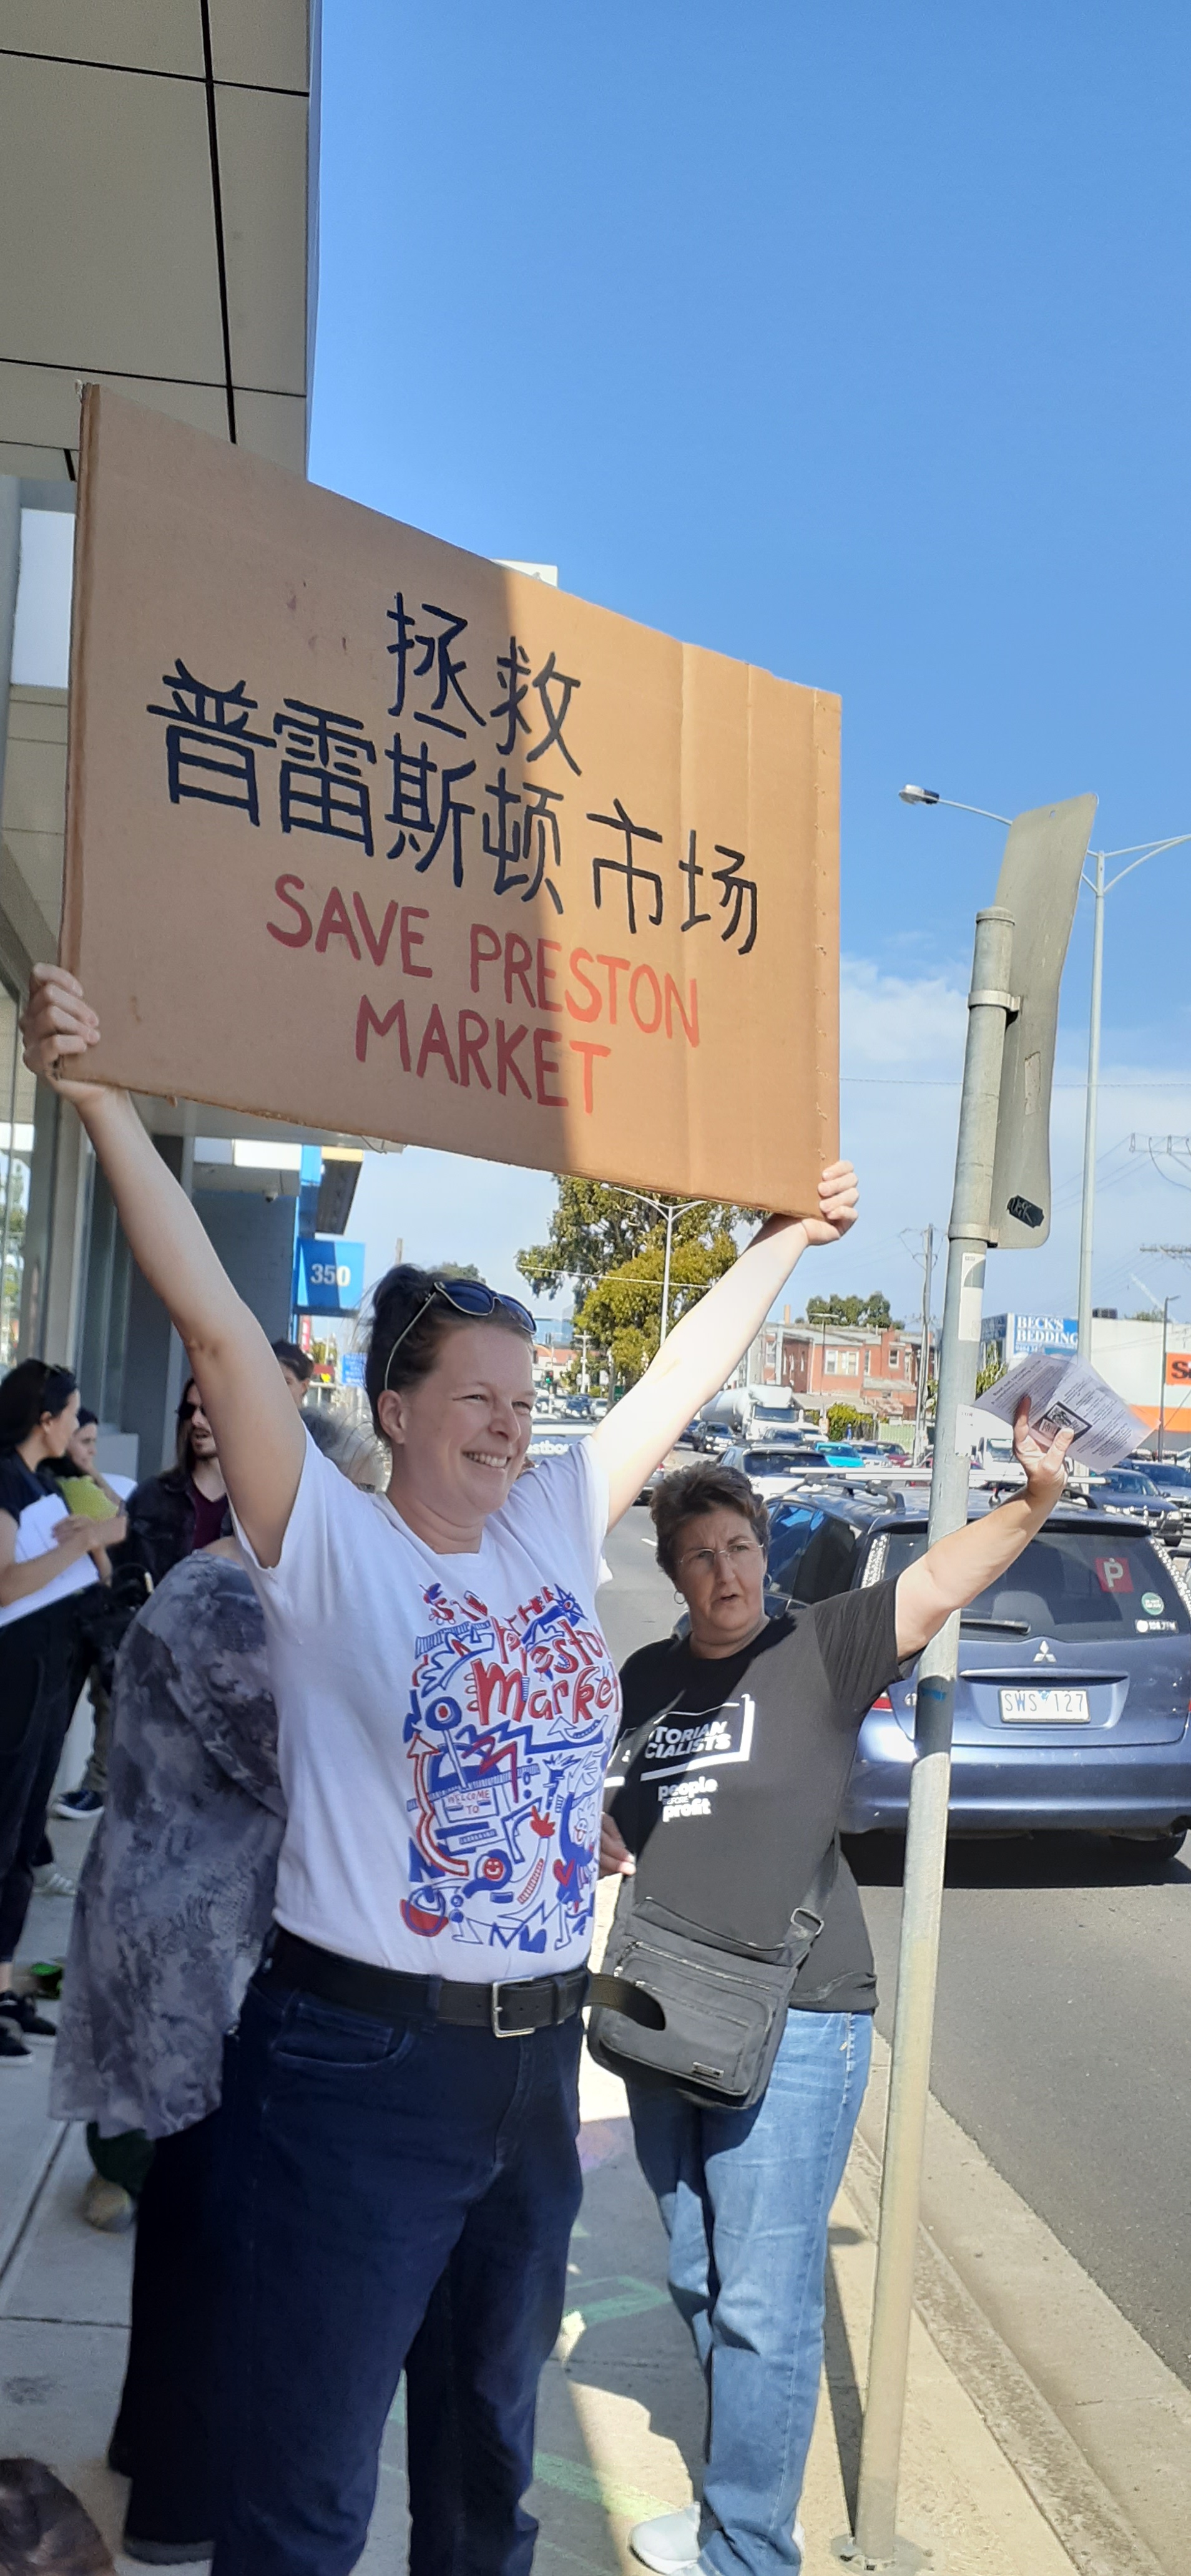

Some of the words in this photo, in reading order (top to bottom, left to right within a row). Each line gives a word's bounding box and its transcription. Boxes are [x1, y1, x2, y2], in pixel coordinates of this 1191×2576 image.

[387, 592, 582, 776] 拯救
[267, 873, 433, 978] SAVE
[470, 924, 700, 1048] PRESTON
[355, 995, 611, 1114] MARKET
[310, 1264, 351, 1287] 350
[1017, 1316, 1064, 1330] BECK'S
[1016, 1329, 1078, 1344] BEDDING
[1104, 1561, 1123, 1588] P
[1004, 1687, 1037, 1712] SWS
[1055, 1687, 1083, 1712] 127
[649, 1721, 727, 1744] TORIAN
[645, 1733, 731, 1759] CIALISTS
[448, 1790, 490, 1804] WELCOME
[658, 1777, 718, 1801] people
[466, 1804, 479, 1814] TO
[663, 1798, 712, 1822] profit
